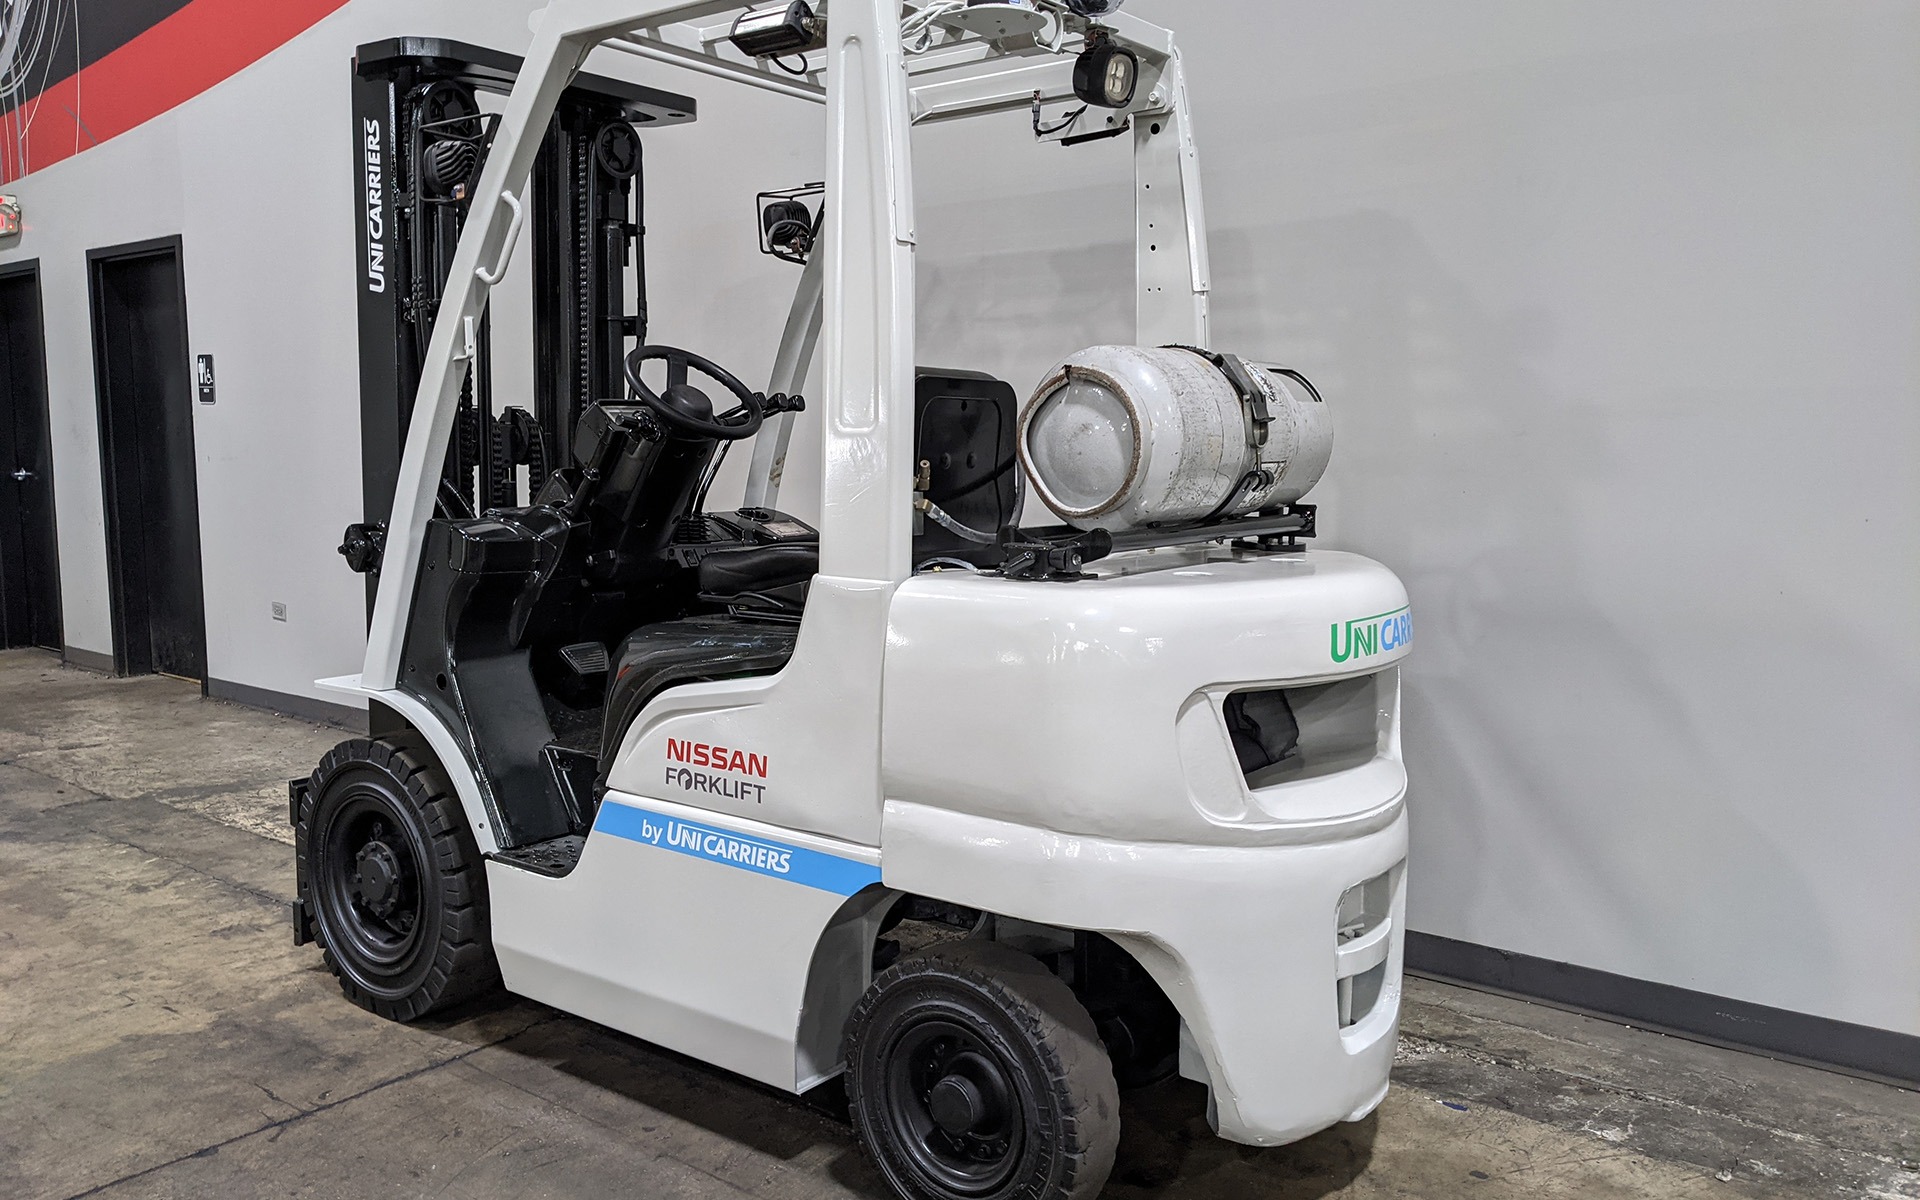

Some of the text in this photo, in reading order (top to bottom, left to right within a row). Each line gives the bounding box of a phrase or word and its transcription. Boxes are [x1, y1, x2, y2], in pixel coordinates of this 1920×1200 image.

[666, 738, 768, 778] NISSAN
[665, 767, 766, 804] FORKLIFT
[641, 819, 663, 845] by
